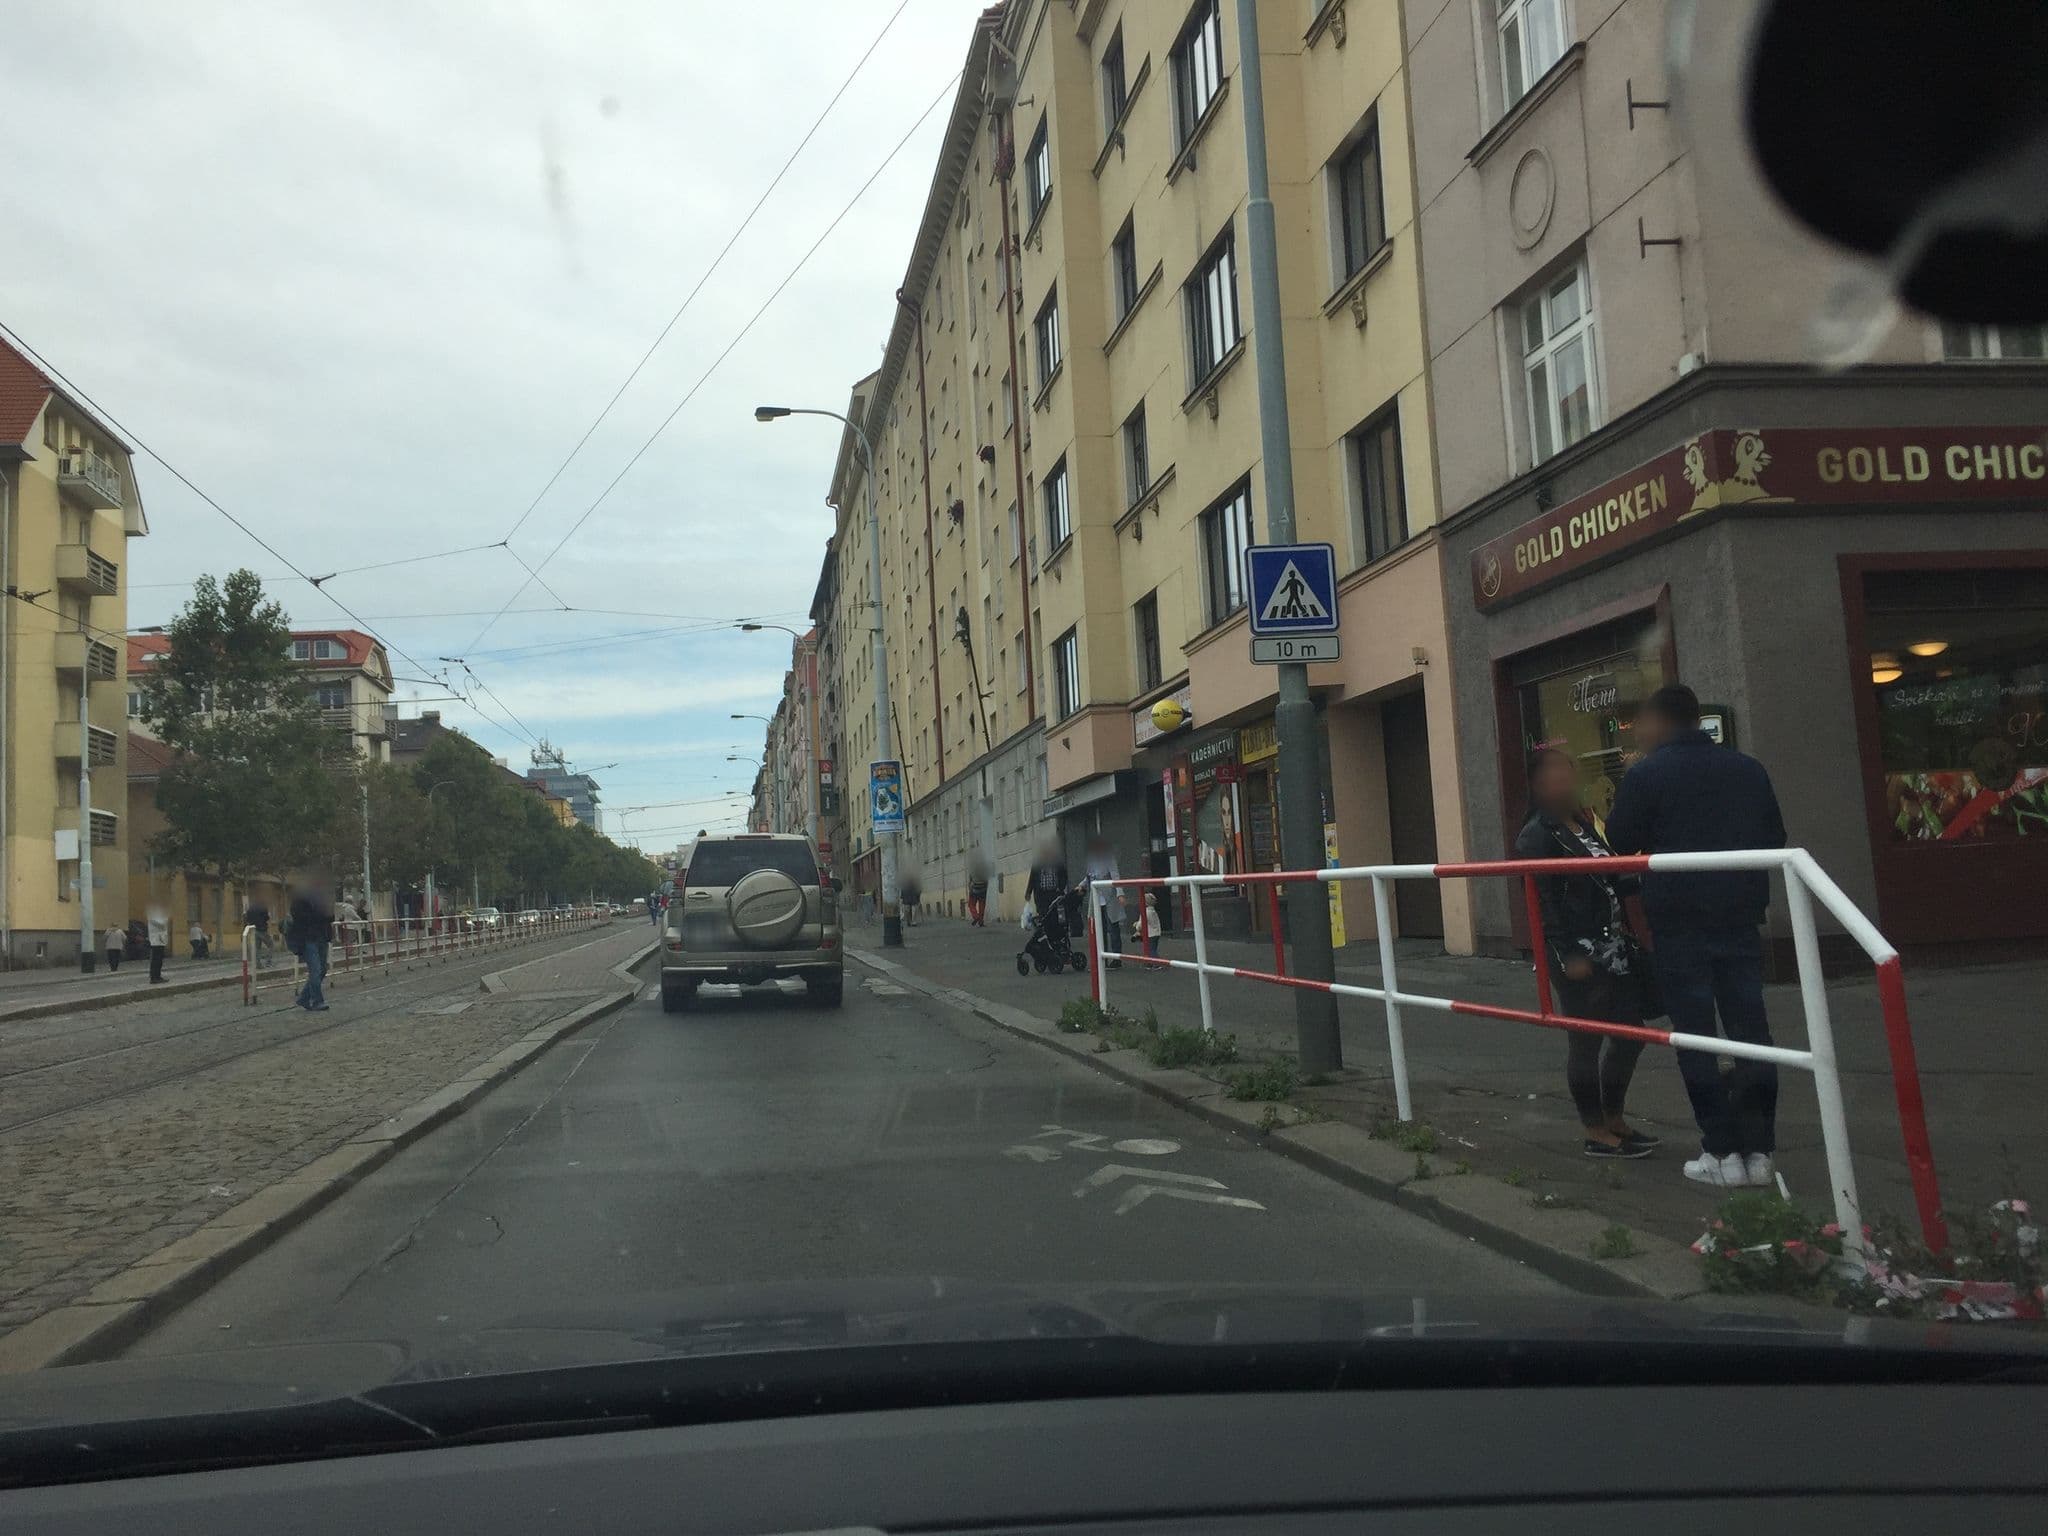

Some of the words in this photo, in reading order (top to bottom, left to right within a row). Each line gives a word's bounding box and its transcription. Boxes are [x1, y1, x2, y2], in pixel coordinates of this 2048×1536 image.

[1816, 445, 1930, 483] GOLD
[1514, 525, 1564, 574] GOLD
[1569, 473, 1668, 549] CHICKEN
[1276, 641, 1293, 657] 10
[1301, 645, 1317, 657] m
